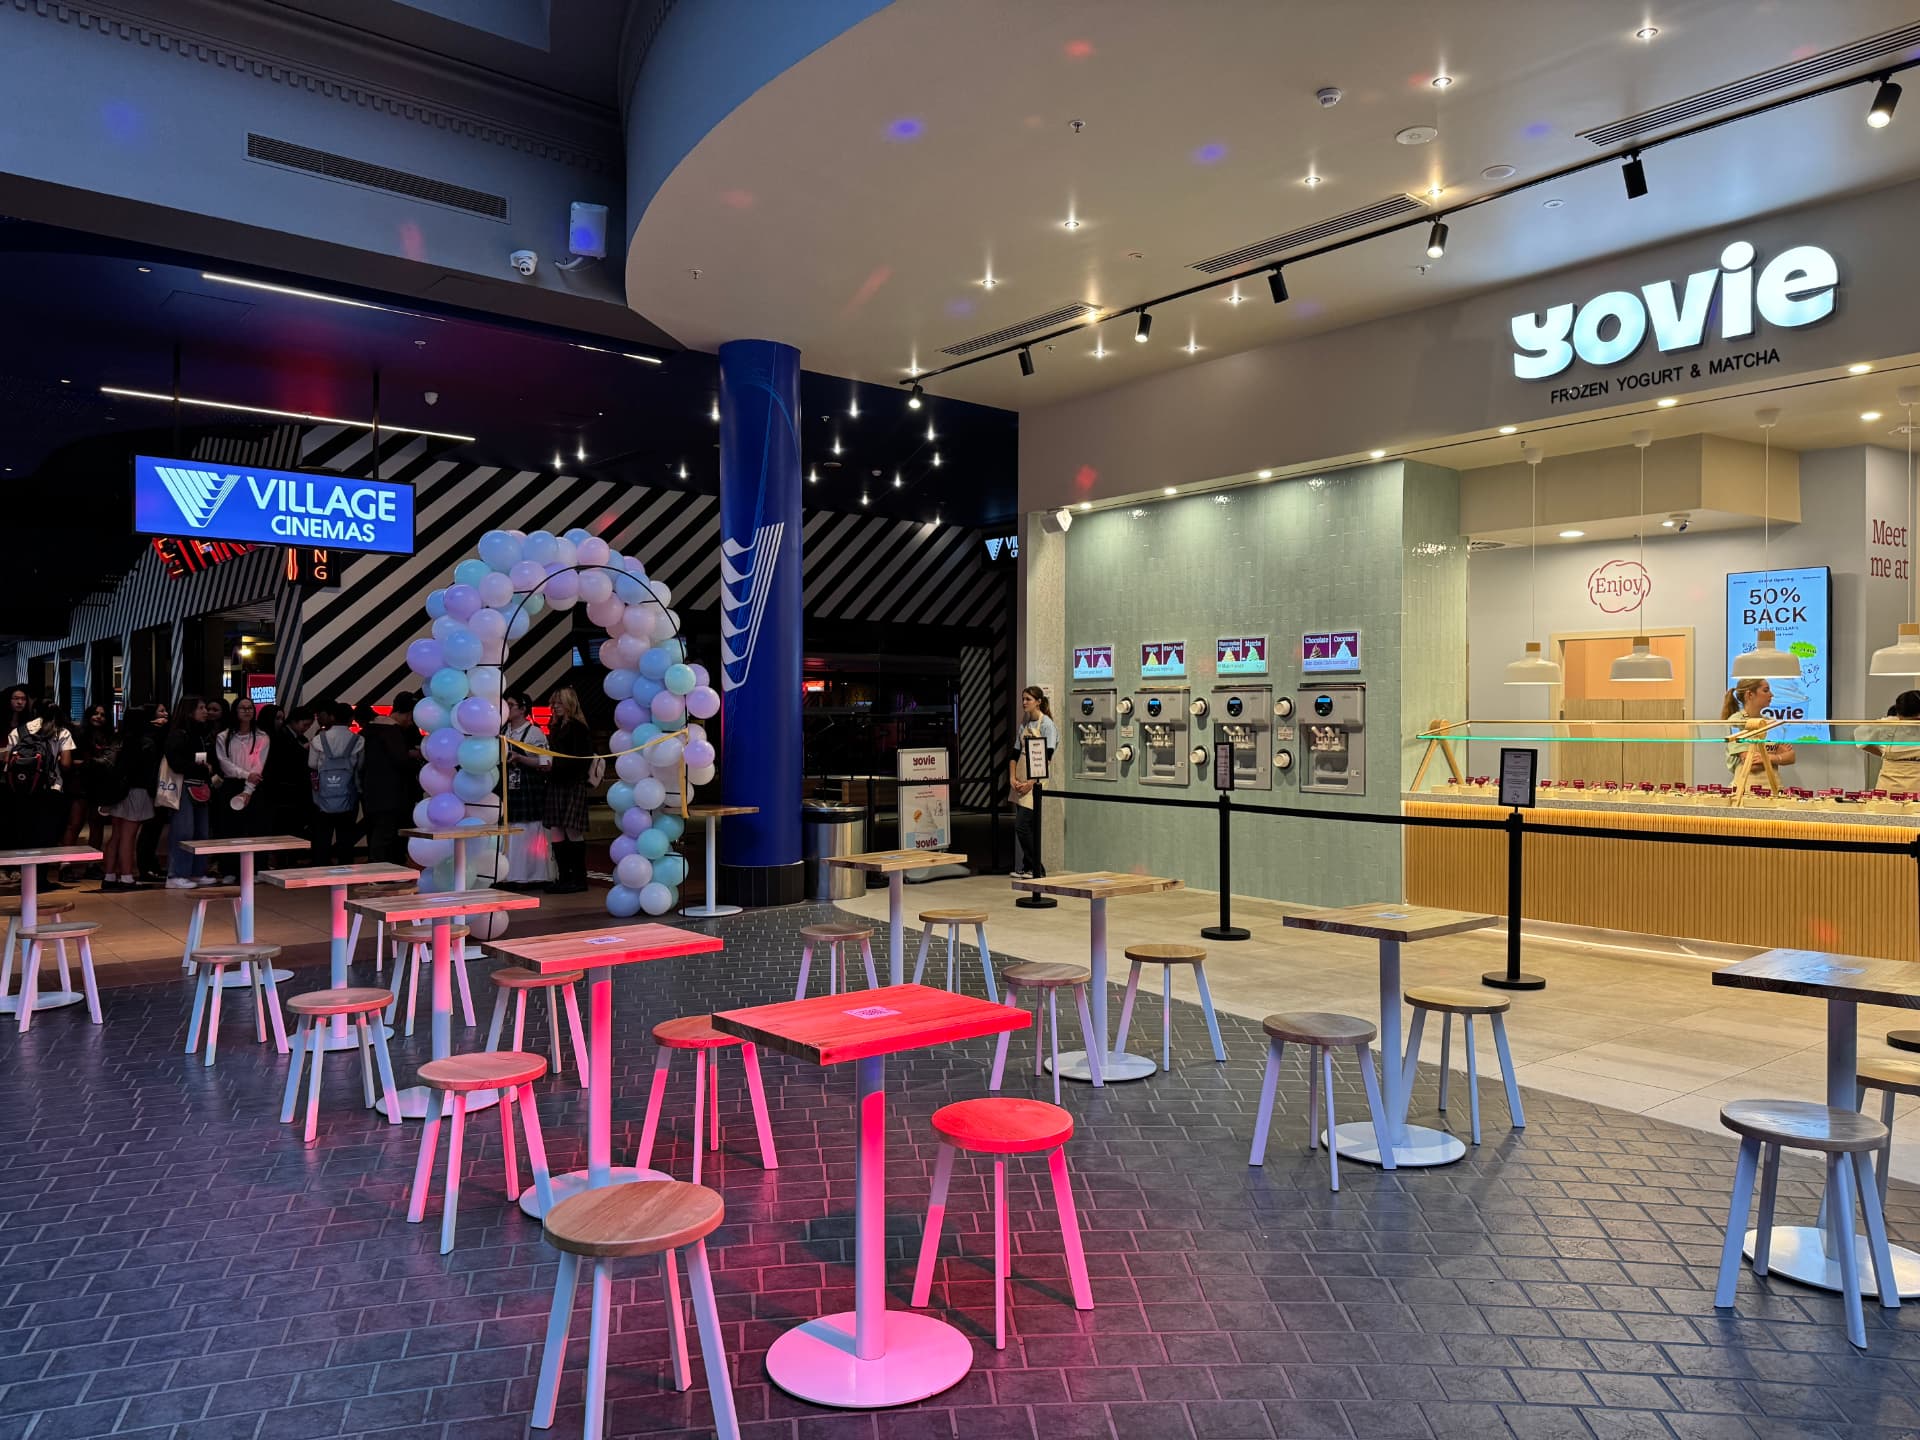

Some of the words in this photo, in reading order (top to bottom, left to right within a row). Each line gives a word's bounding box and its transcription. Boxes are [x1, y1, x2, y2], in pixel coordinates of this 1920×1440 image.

[1511, 240, 1839, 380] yovie
[1550, 380, 1609, 404] FROZEN
[1617, 366, 1684, 392] YOGURT
[1690, 363, 1701, 378] &
[1709, 348, 1780, 375] MATCHA
[246, 476, 396, 522] VILLAGE
[271, 515, 376, 543] CINEMAS
[1872, 519, 1907, 548] Meet
[1870, 556, 1892, 579] me
[1894, 559, 1909, 580] at
[1594, 575, 1643, 597] Enjoy
[1749, 586, 1801, 605] 50%
[1743, 606, 1808, 625] BACK
[1761, 706, 1804, 720] ovie
[912, 755, 936, 766] yovie
[915, 837, 938, 849] yovie
